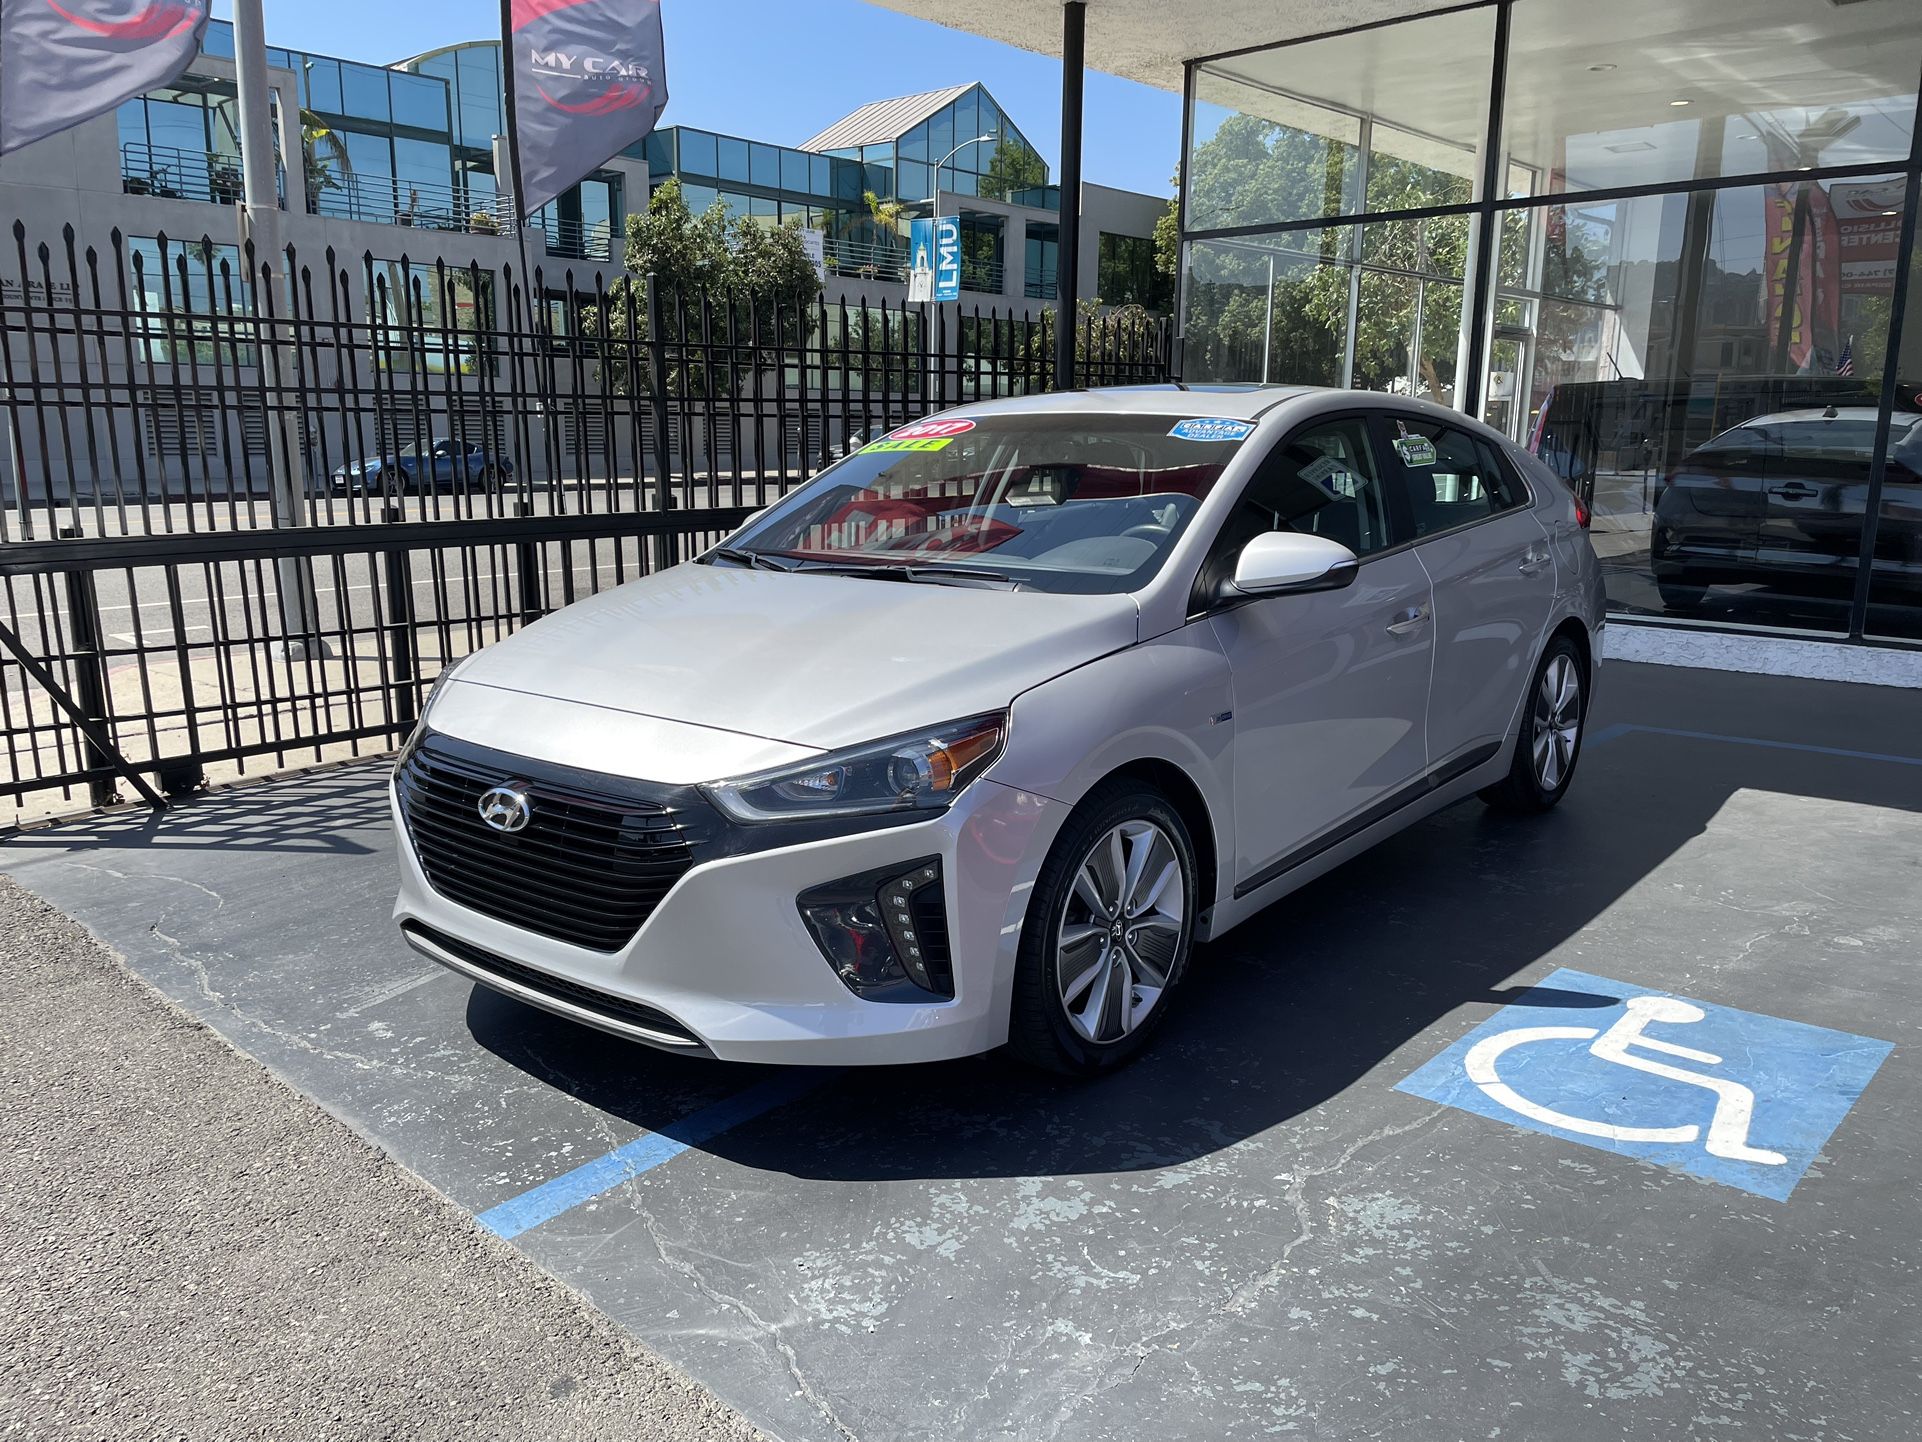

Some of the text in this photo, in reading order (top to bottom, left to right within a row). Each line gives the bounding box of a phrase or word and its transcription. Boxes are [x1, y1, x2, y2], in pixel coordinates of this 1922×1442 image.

[531, 49, 649, 79] MY CAR
[939, 222, 958, 288] LMU
[895, 422, 970, 438] 2017
[1182, 428, 1237, 436] ADVANTAGE
[870, 440, 938, 451] SALE
